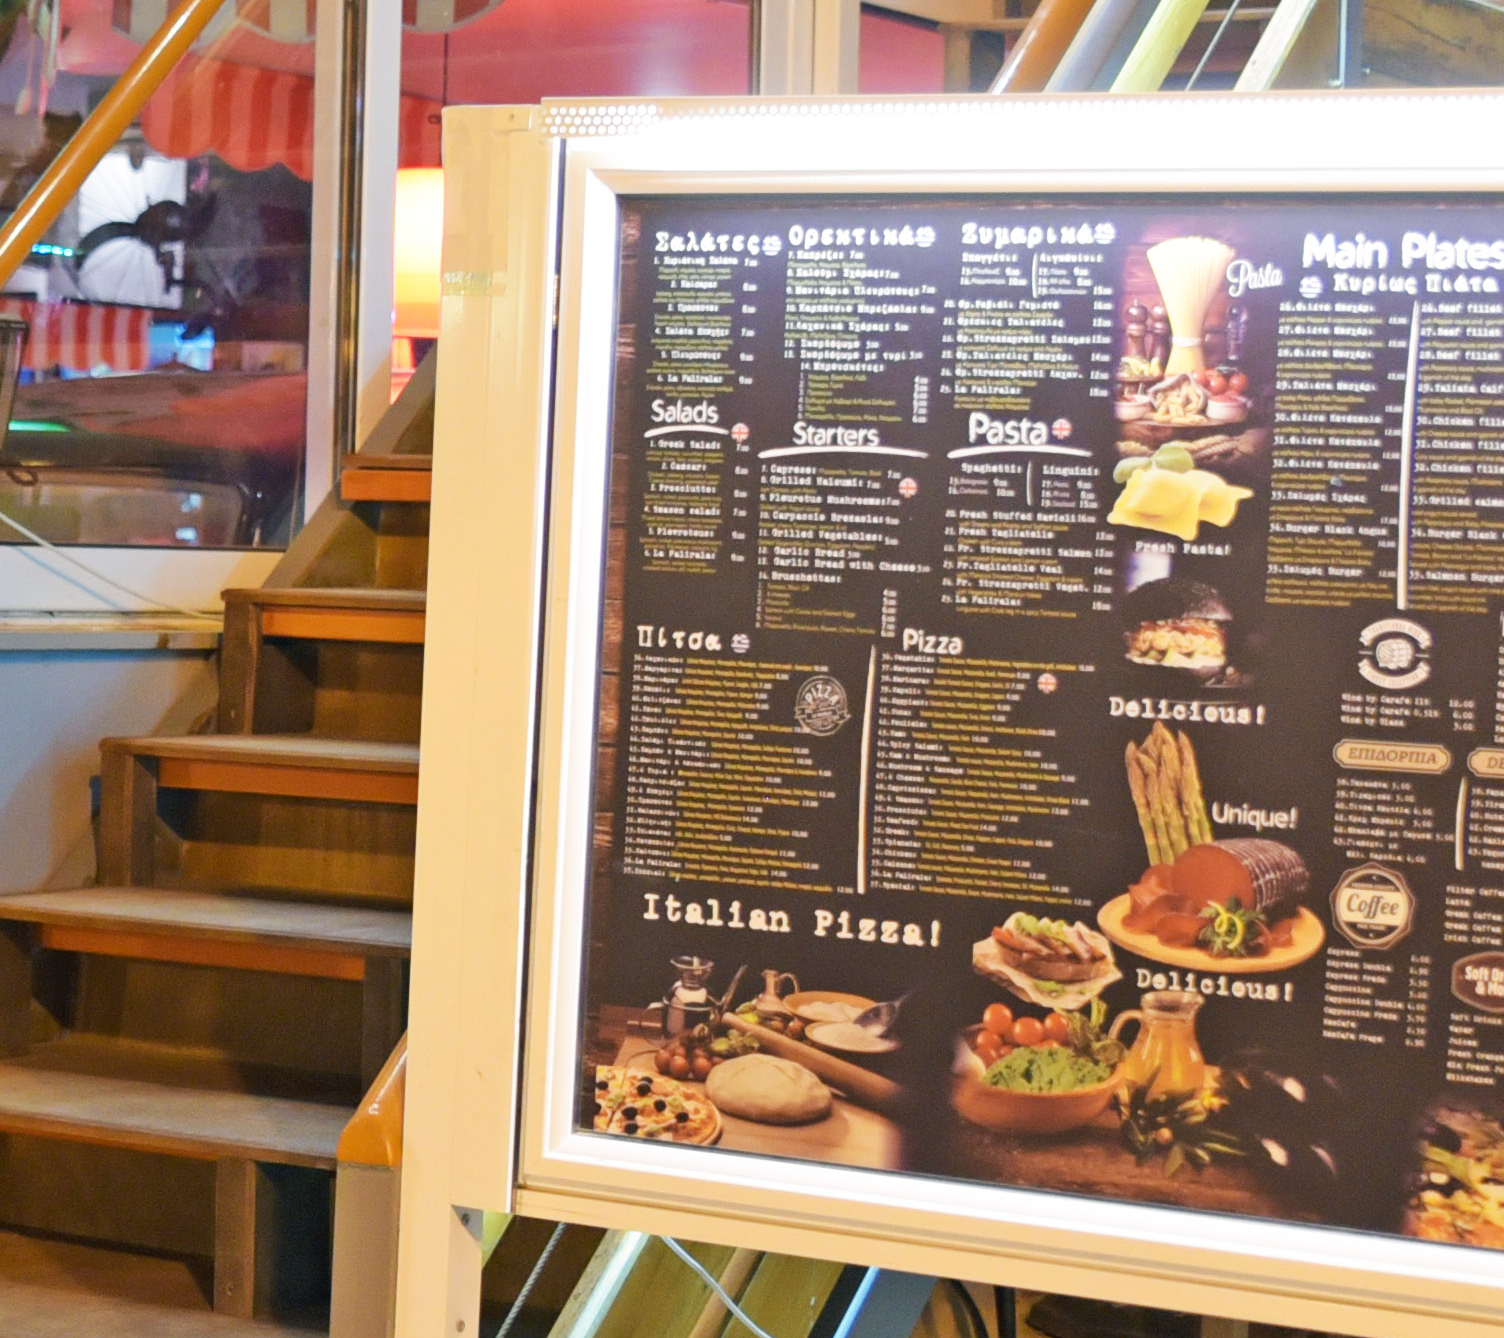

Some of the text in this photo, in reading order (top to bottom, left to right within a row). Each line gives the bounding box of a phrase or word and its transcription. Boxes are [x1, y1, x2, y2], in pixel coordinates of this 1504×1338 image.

[655, 231, 760, 255] Σαλάτες
[788, 225, 917, 249] Ορεκτικά
[962, 222, 1094, 249] Ζυμαρικά
[1302, 232, 1389, 269] Main
[1226, 259, 1283, 298] Pasta
[1333, 273, 1500, 296] Κυρίως Πιάτα
[651, 399, 719, 424] Salads
[792, 421, 880, 447] Starters
[969, 412, 1048, 445] Pasta
[1134, 539, 1232, 558] Fresh Pasta!
[637, 625, 722, 651] Πίτσα
[903, 628, 964, 655] Pizza
[804, 682, 841, 707] PIZZA
[1109, 696, 1266, 726] Delicious!
[1212, 802, 1299, 831] Unique!
[1346, 893, 1400, 919] Coffee
[643, 893, 944, 949] Italian Pizza!
[1136, 968, 1293, 1002] Delicious!
[1464, 965, 1489, 981] Soft
[1475, 983, 1486, 995] &
